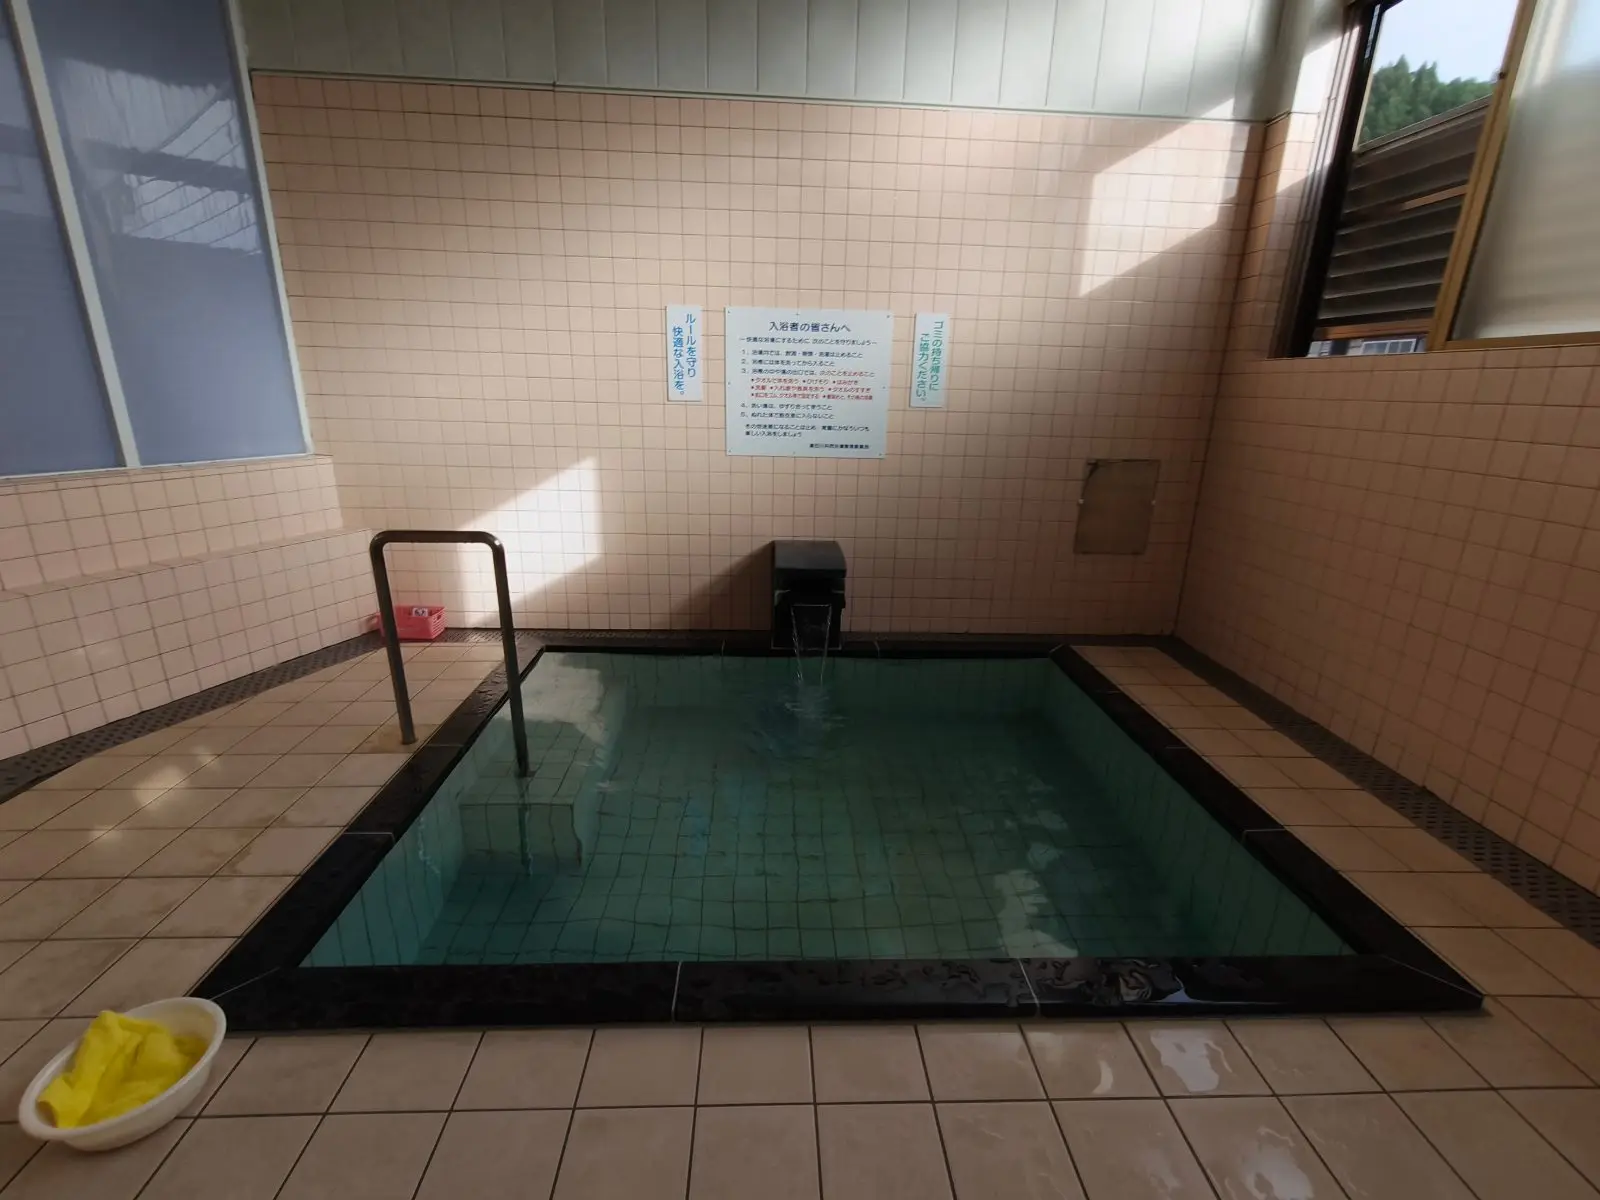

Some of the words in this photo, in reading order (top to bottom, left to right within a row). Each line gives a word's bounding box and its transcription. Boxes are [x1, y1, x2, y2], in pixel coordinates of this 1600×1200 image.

[672, 325, 685, 396] 快適な入浴を。
[685, 313, 697, 378] ルールを守り
[769, 321, 851, 332] 入浴者の皆さんへ
[928, 321, 944, 391] ゴミの持ち帰りに
[915, 333, 930, 401] ご協力ください。
